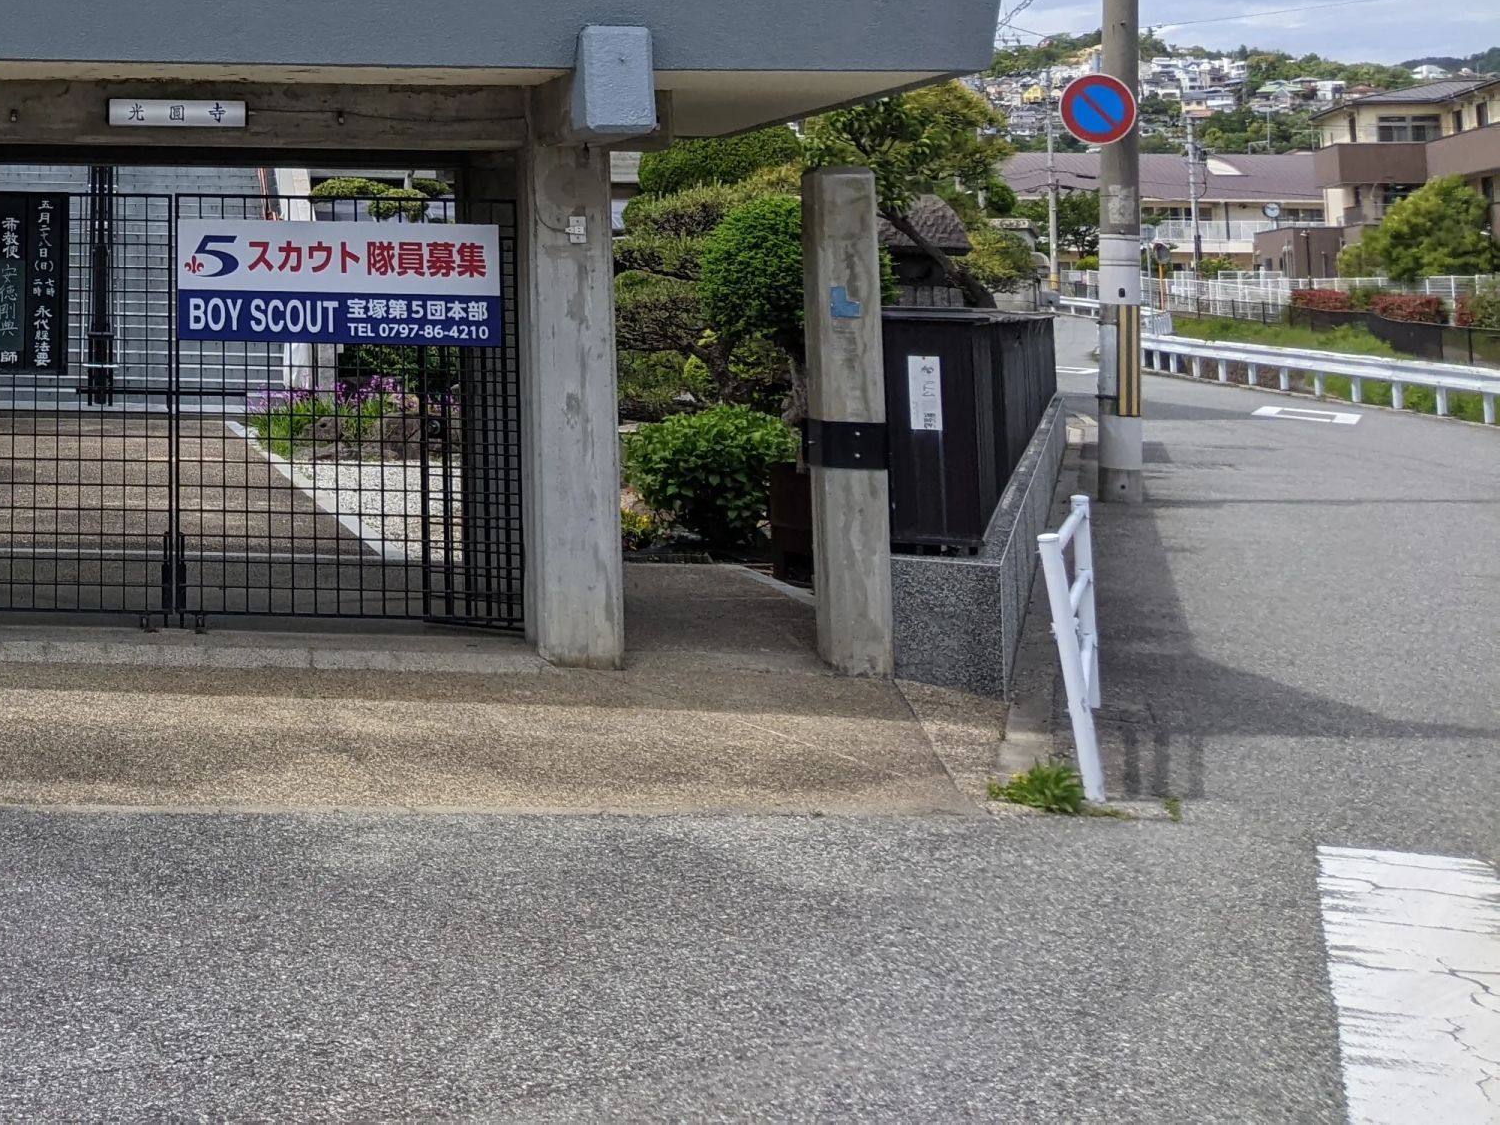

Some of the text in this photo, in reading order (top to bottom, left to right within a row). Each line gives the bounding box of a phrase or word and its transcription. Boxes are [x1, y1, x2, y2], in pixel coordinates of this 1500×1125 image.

[127, 102, 227, 124] 光圓寺
[247, 240, 488, 278] スカウト隊員募集
[188, 297, 340, 334] BOY SCOUT
[346, 297, 490, 322] 宝塚第5団本部
[347, 322, 489, 341] TEL 0797-86-4210
